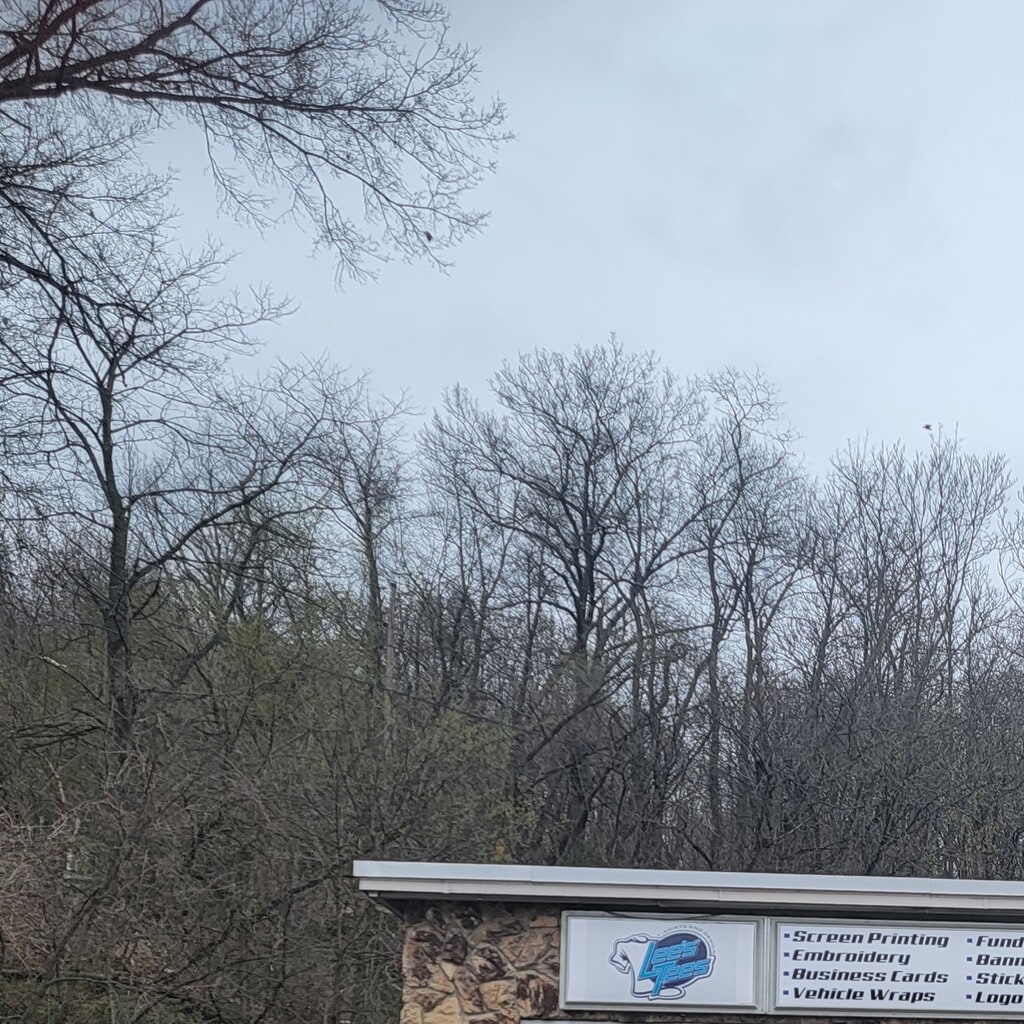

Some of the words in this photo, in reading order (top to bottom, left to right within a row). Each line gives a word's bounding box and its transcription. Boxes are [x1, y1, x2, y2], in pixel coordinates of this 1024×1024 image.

[792, 930, 864, 944] Screen
[867, 932, 949, 948] Printing
[792, 949, 911, 966] Embroidery
[651, 958, 711, 997] Tees
[791, 968, 887, 982] Business
[890, 970, 949, 984] Cards
[793, 987, 865, 1001] Vehicle
[869, 989, 936, 1004] Wraps
[975, 991, 1023, 1006] Logo
